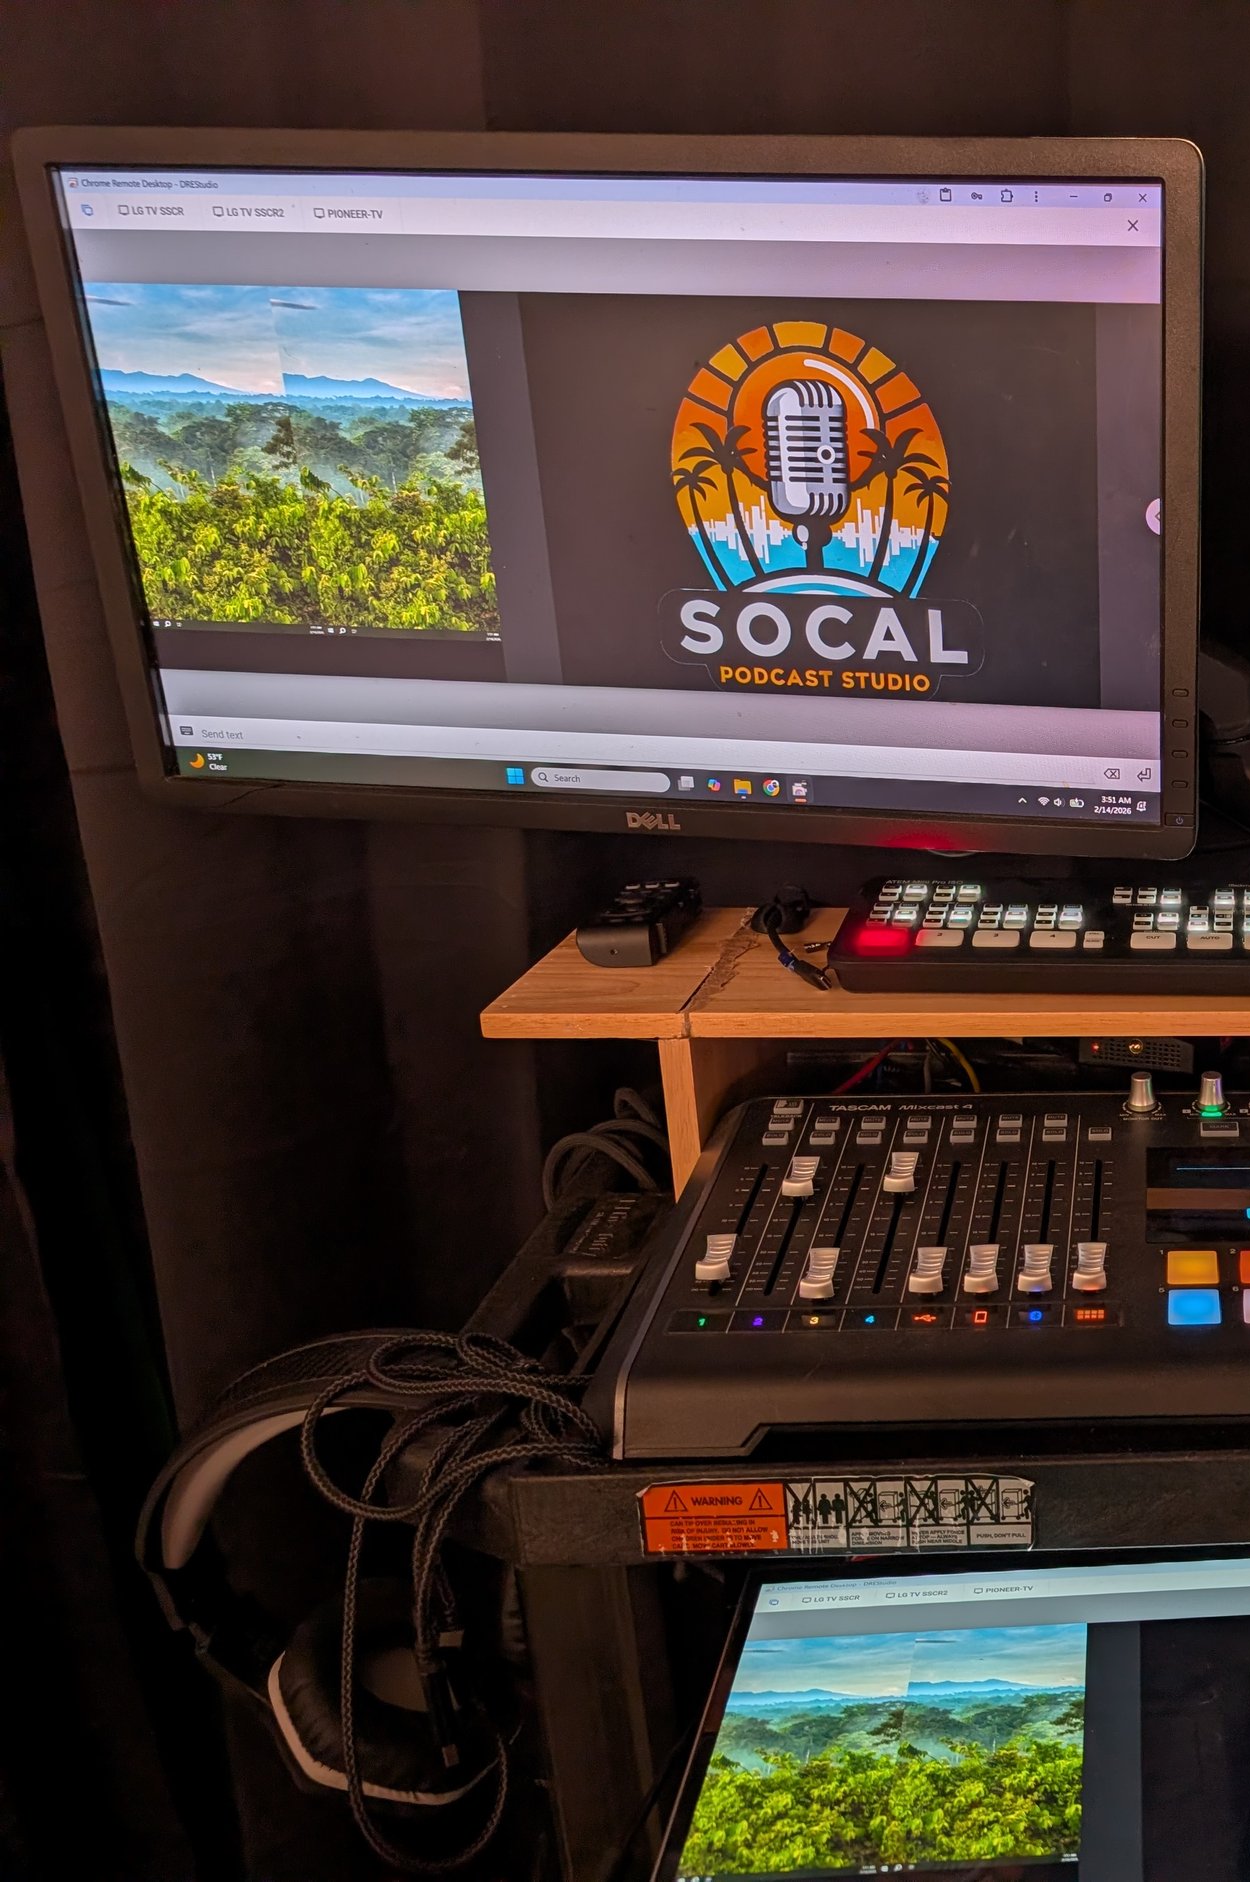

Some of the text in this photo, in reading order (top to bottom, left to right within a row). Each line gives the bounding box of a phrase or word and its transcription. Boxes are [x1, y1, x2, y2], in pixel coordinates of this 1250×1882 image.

[81, 178, 111, 188] Chrome
[112, 179, 141, 188] Remote
[142, 179, 172, 190] Desktop
[132, 206, 184, 216] LG TV SSCR
[226, 208, 285, 218] LG TV SSCR2
[327, 209, 383, 219] PIONEER-TV
[680, 599, 968, 664] SOCAL
[719, 665, 931, 692] PODCAST STUDIO
[201, 729, 244, 740] Send text
[207, 752, 223, 761] 53°F
[209, 763, 228, 771] Clear
[554, 774, 581, 783] Search
[1101, 795, 1132, 804] 3:51 AM
[1093, 806, 1132, 815] 2/14/2026
[625, 811, 681, 830] DELL
[828, 1104, 892, 1112] TASCAM
[899, 1103, 960, 1111] Mixcast
[699, 1317, 706, 1326] 1
[752, 1317, 763, 1326] 2
[809, 1316, 819, 1325] 3
[865, 1315, 875, 1324] 4
[690, 1496, 743, 1507] WARNING
[985, 1585, 1033, 1594] PIONEER-TV
[897, 1591, 908, 1599] LG
